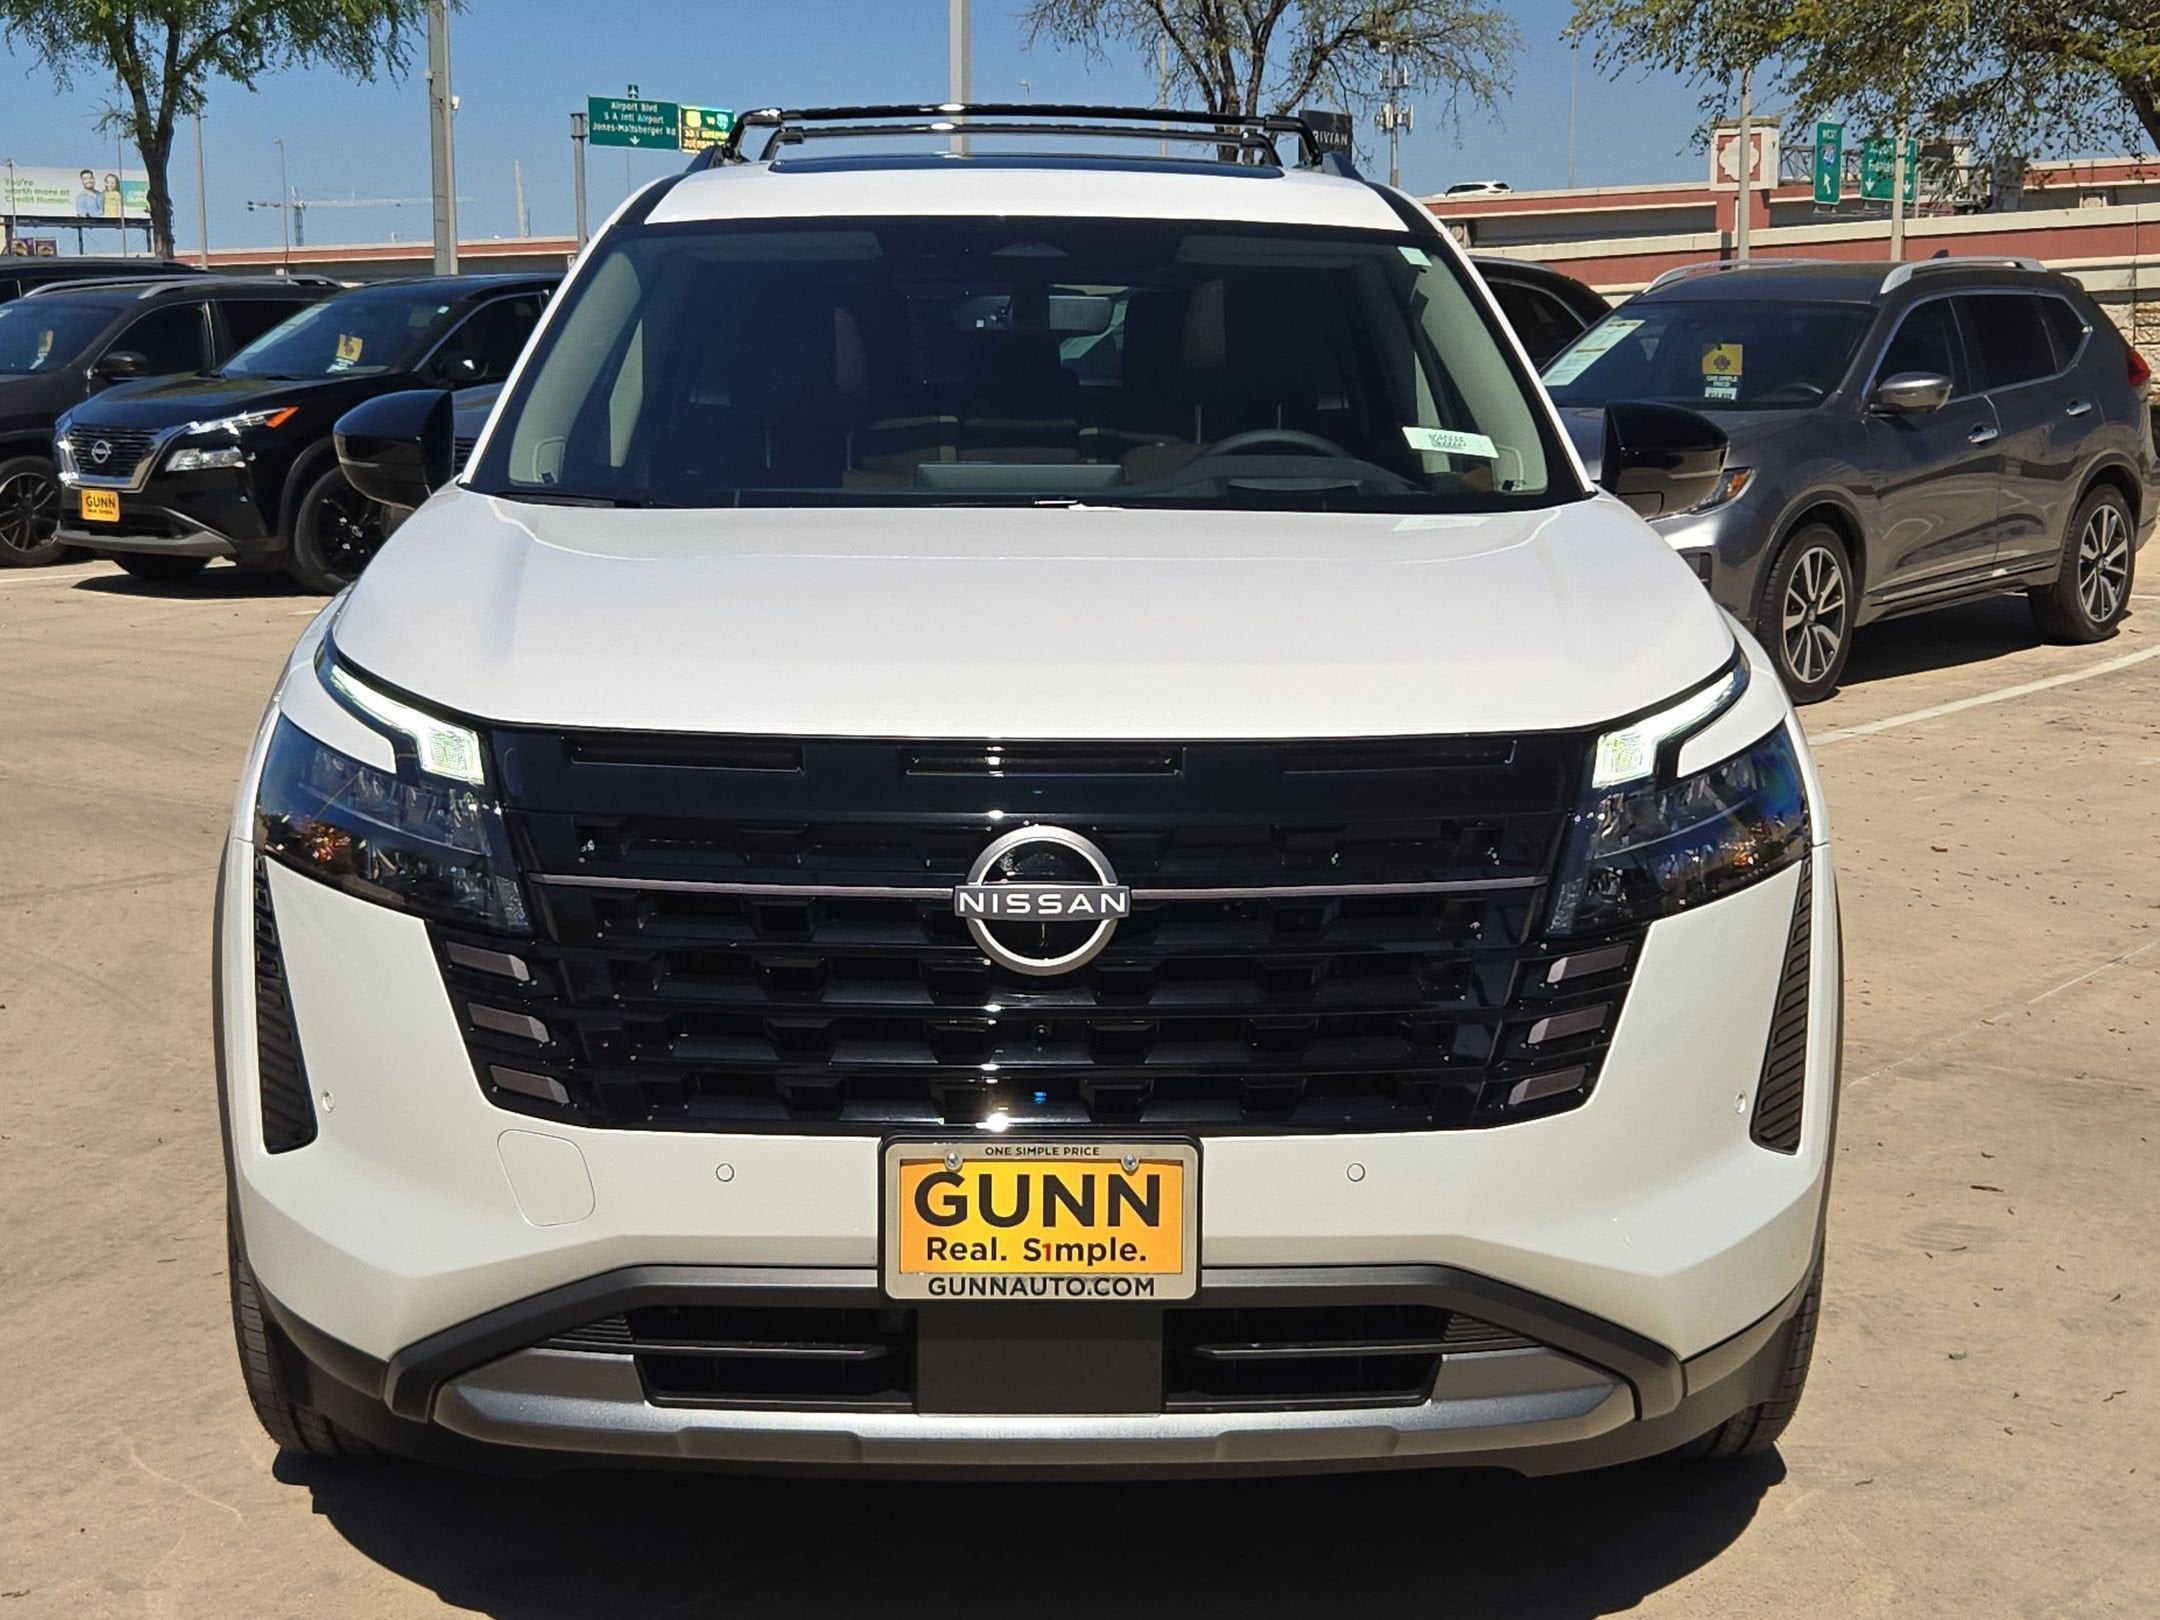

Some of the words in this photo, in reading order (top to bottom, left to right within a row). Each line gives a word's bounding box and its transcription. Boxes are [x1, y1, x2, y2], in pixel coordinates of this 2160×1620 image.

[611, 101, 638, 112] Airport
[641, 102, 658, 113] Blvd
[612, 112, 619, 121] A
[637, 113, 664, 124] Airport
[666, 126, 676, 136] Rd
[4, 195, 34, 203] Cedit
[86, 496, 116, 508] GUNN
[959, 892, 1126, 914] NISSAN
[985, 1146, 1014, 1157] ONE
[1016, 1146, 1061, 1157] SIMPLE
[1063, 1146, 1100, 1157] PRICE
[914, 1171, 1160, 1228] GUNN
[927, 1236, 1008, 1262] Real.
[928, 1276, 1155, 1298] GUNNAUTO.COM
